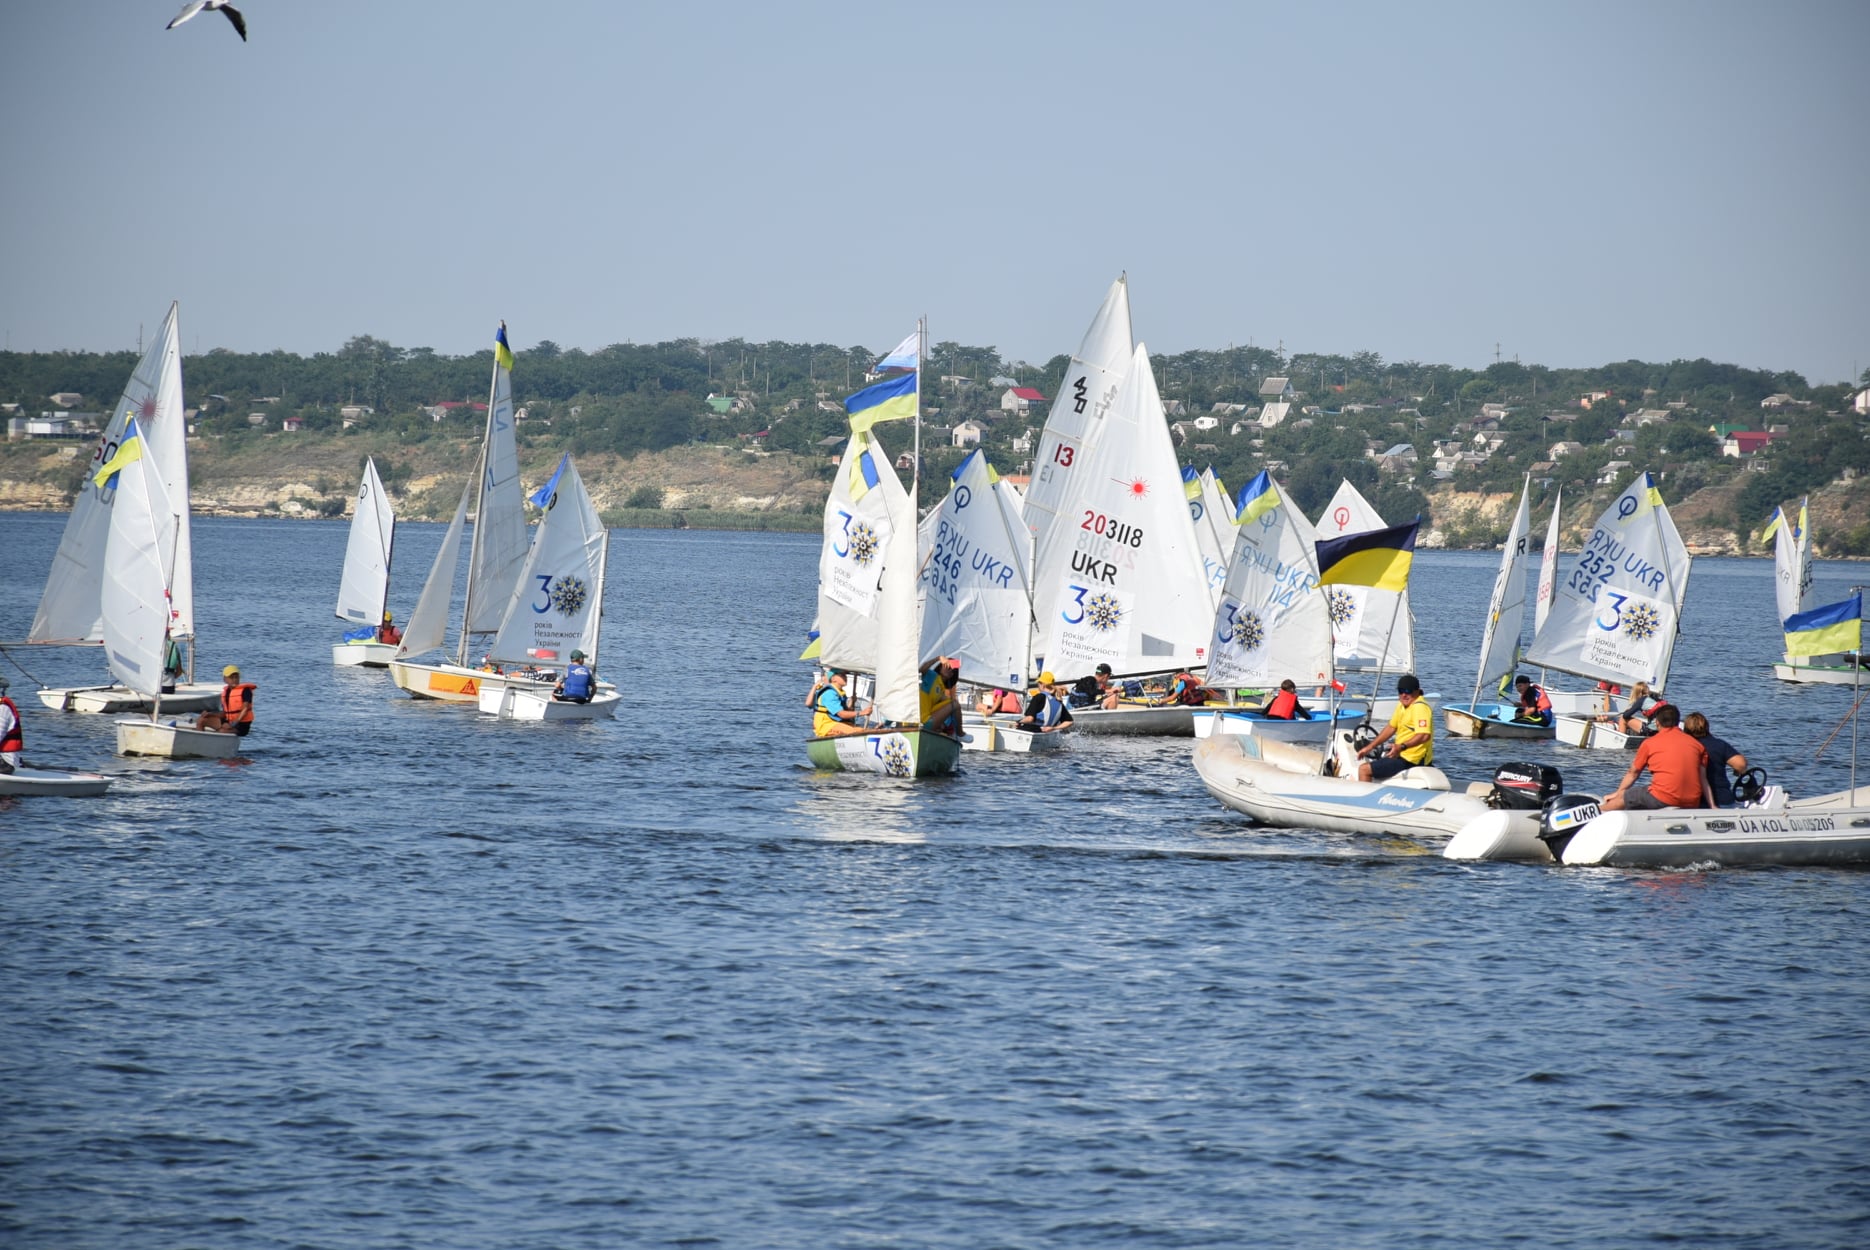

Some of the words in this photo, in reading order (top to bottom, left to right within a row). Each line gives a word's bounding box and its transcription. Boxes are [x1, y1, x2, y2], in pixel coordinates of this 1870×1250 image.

[1054, 443, 1075, 468] 13
[1080, 509, 1144, 548] 203118
[933, 543, 962, 580] 246
[971, 548, 1015, 589] UKR
[1070, 550, 1117, 586] UKR
[1580, 550, 1616, 585] 252
[1624, 552, 1666, 592] UKR
[1274, 561, 1320, 595] UKR
[534, 629, 583, 639] Незалежності
[1062, 631, 1085, 642] років
[1594, 637, 1617, 649] років
[1061, 638, 1119, 657] Незалежності
[1592, 644, 1649, 668] Незалежності
[1498, 771, 1533, 783] MERCURY
[1573, 804, 1598, 822] UKR
[1740, 819, 1759, 833] UA
[1761, 818, 1788, 833] KOL
